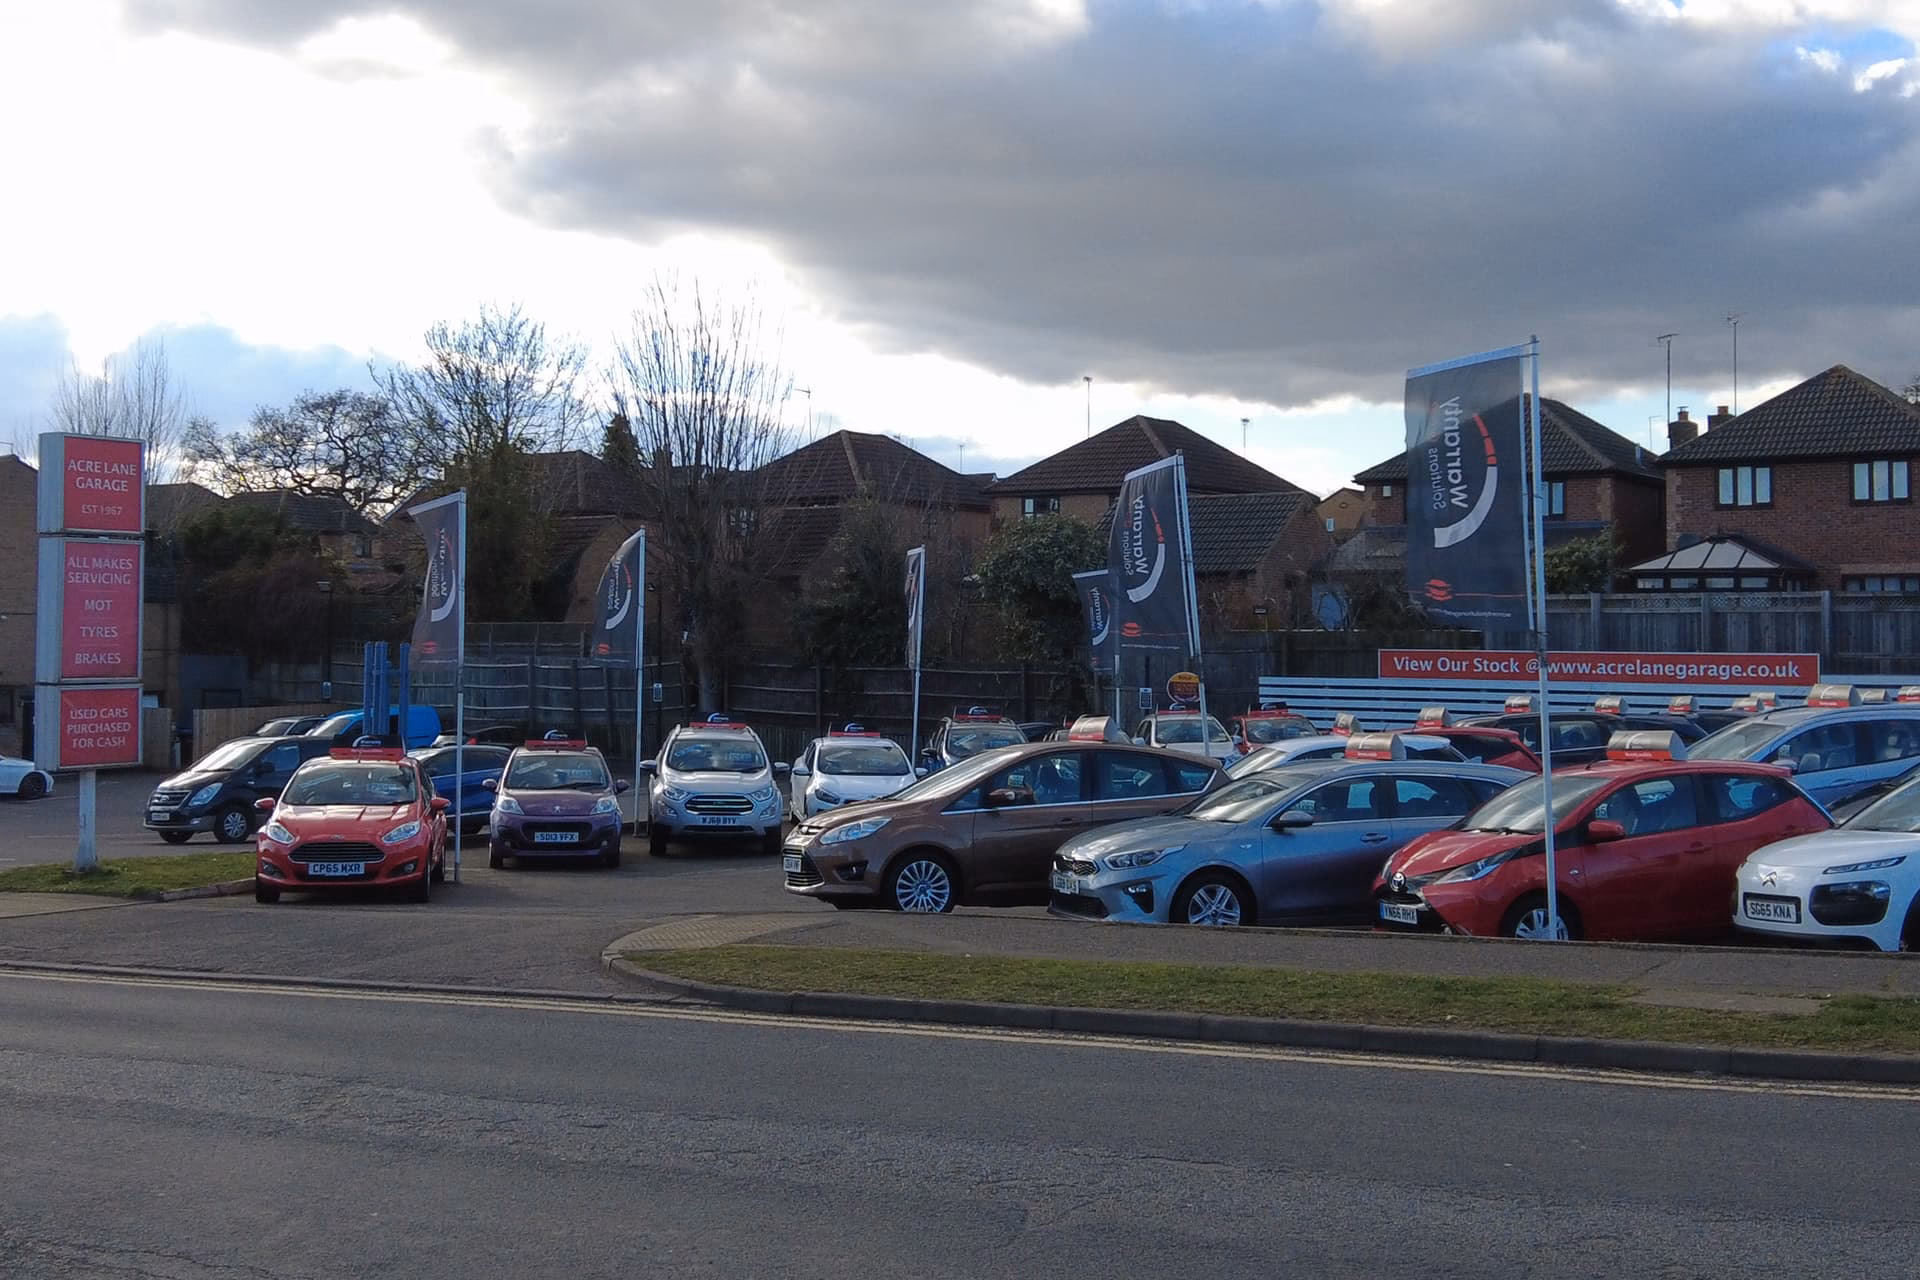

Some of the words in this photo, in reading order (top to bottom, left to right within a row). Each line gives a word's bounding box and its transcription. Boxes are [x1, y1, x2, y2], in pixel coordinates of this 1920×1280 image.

[67, 459, 101, 473] ACRE
[104, 461, 137, 476] LANE
[75, 476, 129, 492] GARAGE
[81, 504, 98, 514] EST
[100, 505, 122, 516] 1967
[67, 556, 89, 568] ALL
[92, 557, 133, 570] MAKES
[67, 571, 131, 585] SERVICING
[84, 599, 112, 611] MOT
[80, 626, 118, 638] TYRES
[74, 652, 121, 665] BRAKES
[1393, 656, 1433, 672] View
[1437, 657, 1469, 673] Our
[1473, 657, 1520, 673] Stock
[1525, 658, 1541, 674] @
[1546, 659, 1800, 680] www.acrelanegarage.co.uk
[70, 708, 98, 720] USED
[100, 707, 129, 719] CARS
[67, 721, 132, 735] PURCHASED
[72, 737, 94, 749] FOR
[96, 736, 126, 748] CASH
[313, 863, 339, 873] CP65
[1750, 902, 1772, 917] SG65
[1773, 904, 1792, 919] KNA
